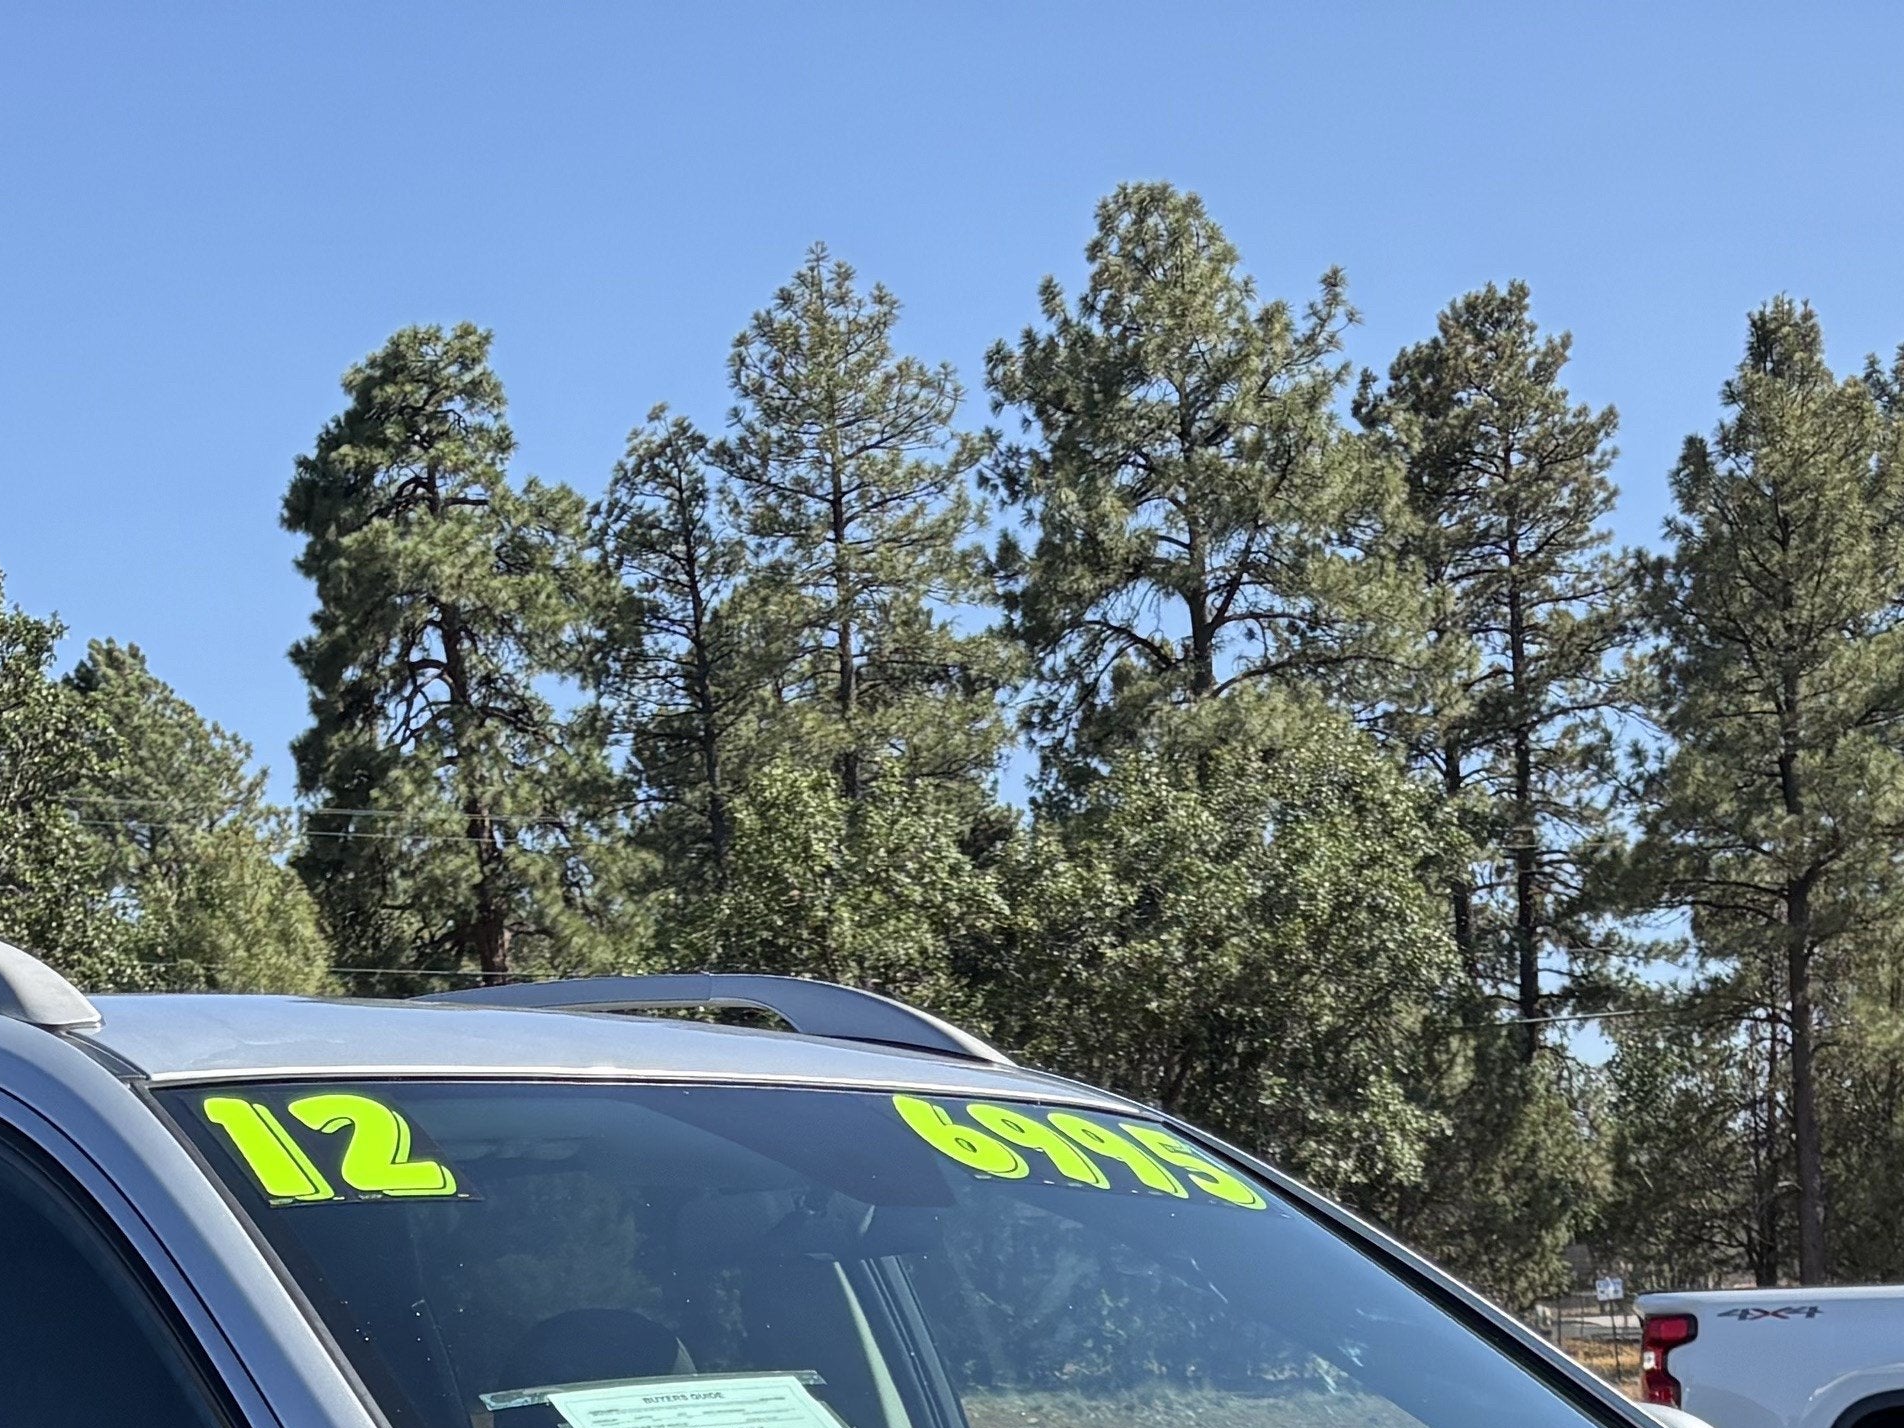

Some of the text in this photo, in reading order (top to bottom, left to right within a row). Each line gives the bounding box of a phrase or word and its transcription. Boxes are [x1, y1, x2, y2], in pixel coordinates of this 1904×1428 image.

[203, 1094, 457, 1200] 12
[892, 1095, 1267, 1210] 6995
[690, 1391, 725, 1401] GUIDE
